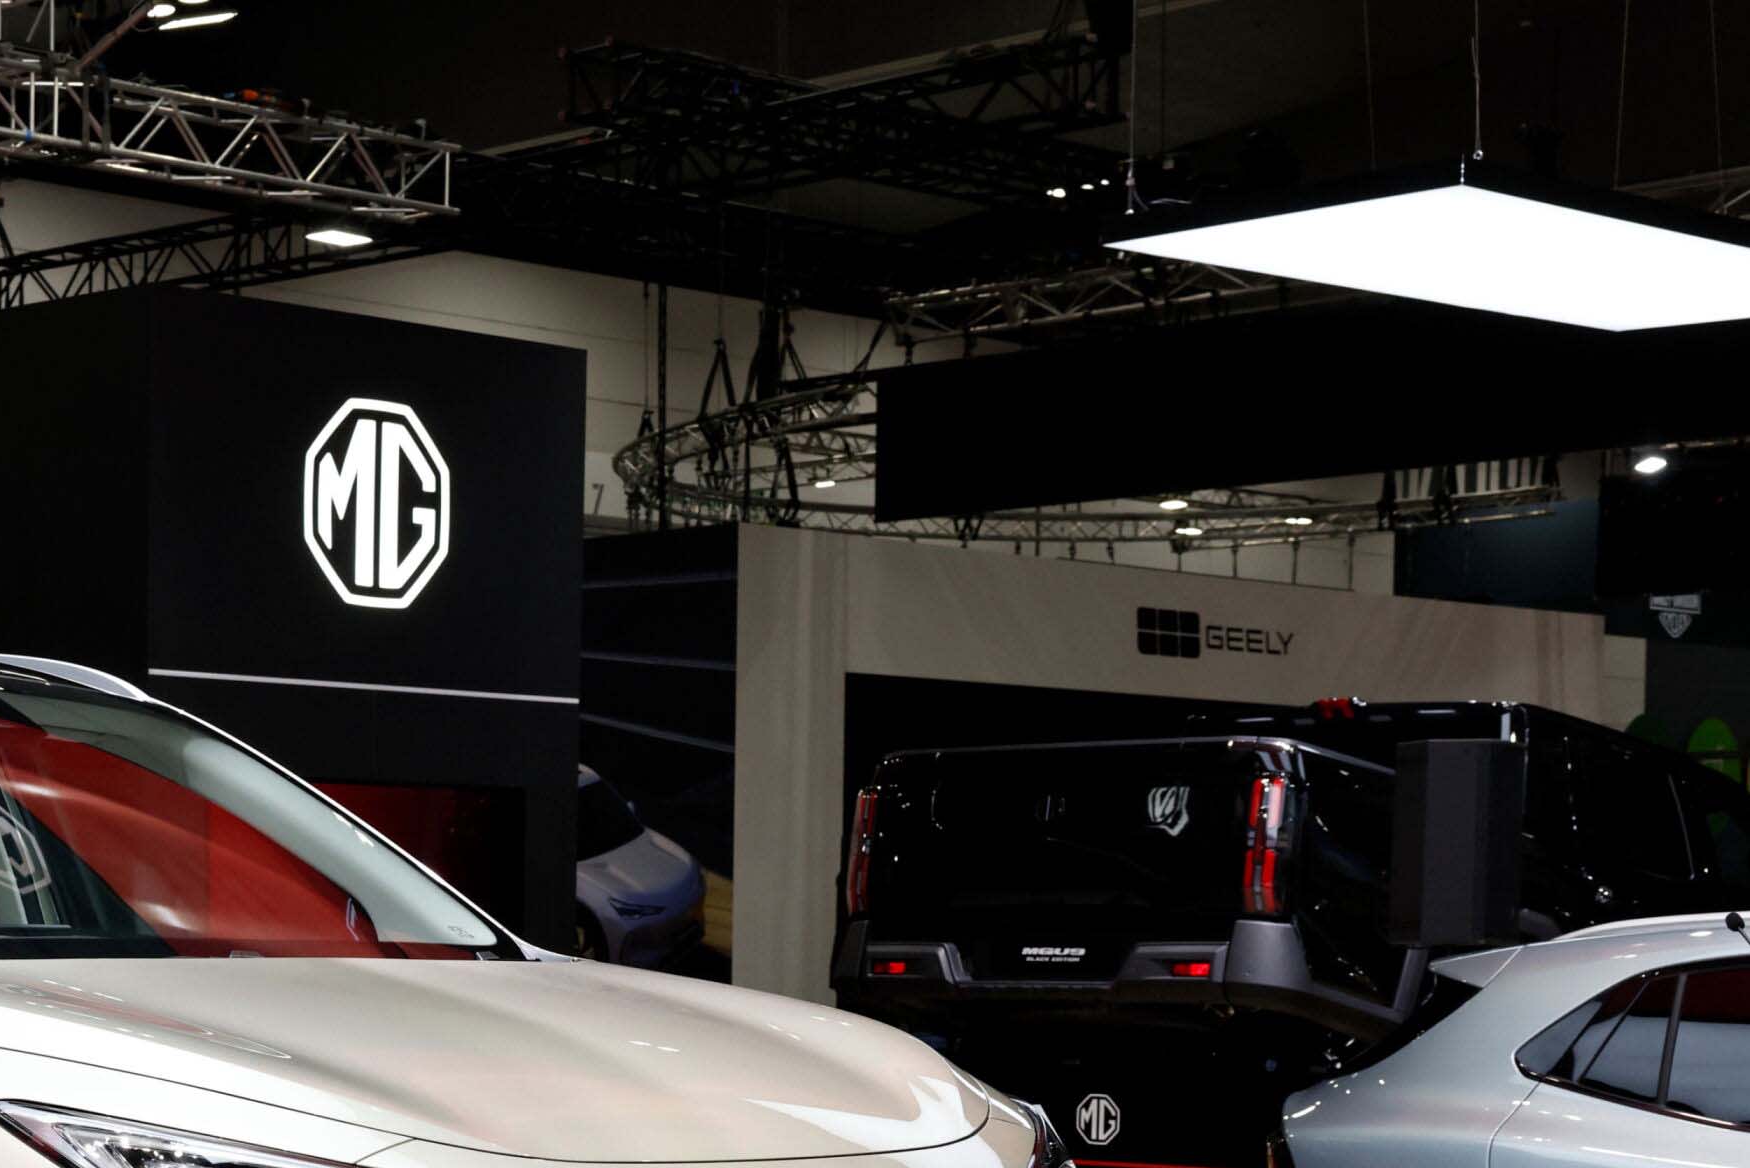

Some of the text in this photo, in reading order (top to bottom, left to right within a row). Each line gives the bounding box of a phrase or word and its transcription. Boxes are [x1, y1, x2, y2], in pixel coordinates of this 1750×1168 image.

[314, 415, 438, 591] MG
[1205, 625, 1294, 655] GEELY
[1079, 1096, 1118, 1141] MG
